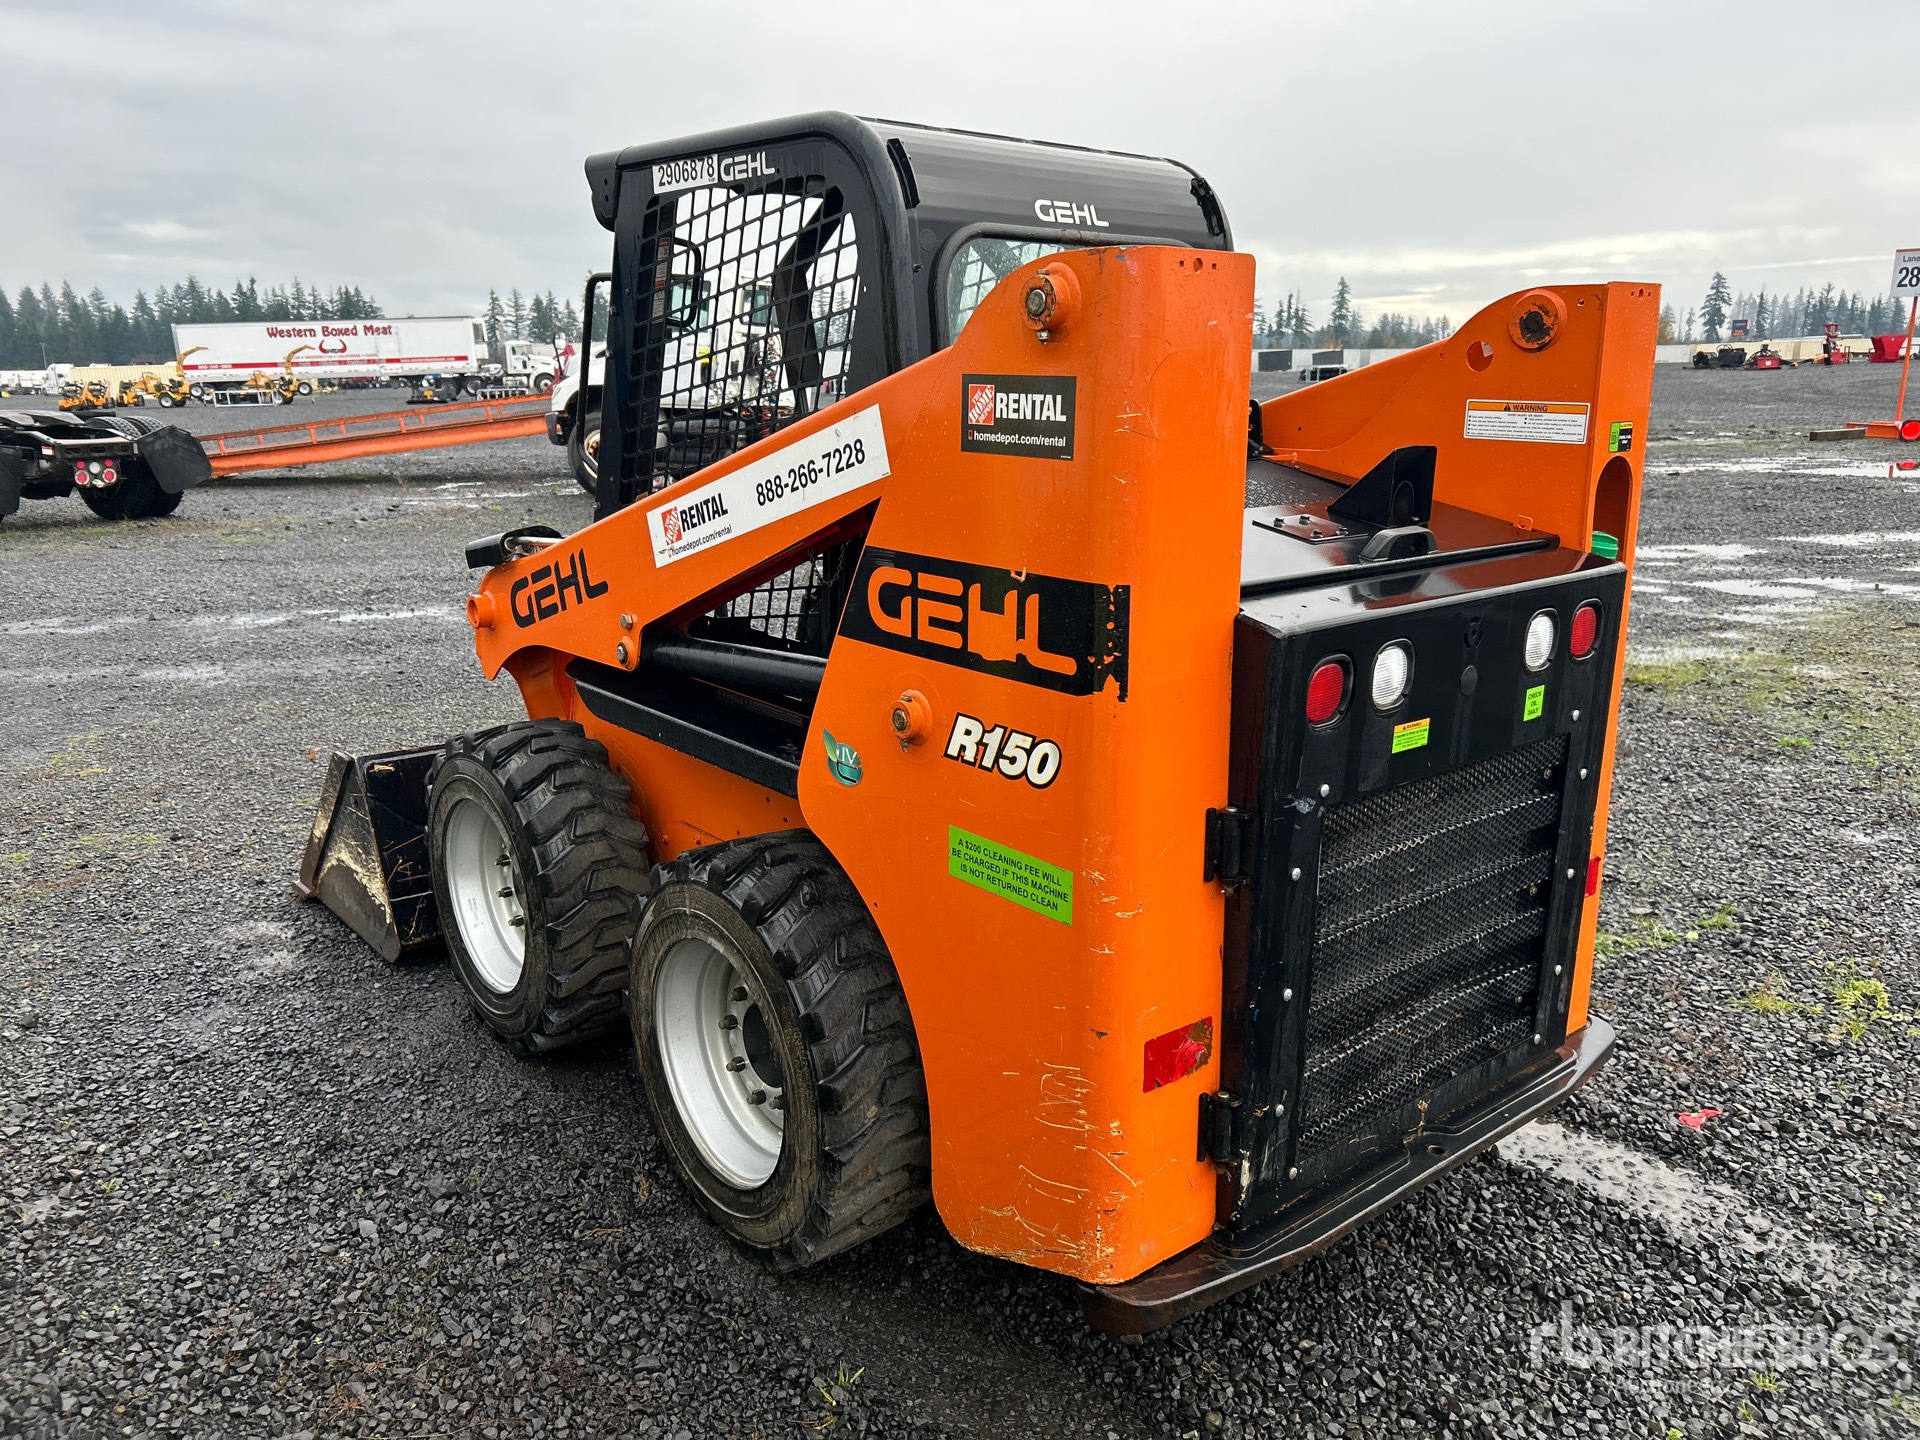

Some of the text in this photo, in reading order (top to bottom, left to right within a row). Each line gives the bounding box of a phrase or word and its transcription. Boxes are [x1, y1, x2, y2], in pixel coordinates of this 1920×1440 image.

[658, 156, 715, 187] 2906878
[720, 151, 776, 182] GEHL
[1034, 199, 1110, 227] GEHL
[266, 324, 393, 338] Western Boxed Meat
[995, 392, 1067, 422] RENTAL
[974, 430, 1066, 447] homedepot.com/rental
[755, 438, 866, 507] 888-266-7228
[680, 492, 729, 533] RENTAL
[510, 548, 609, 629] GEHL
[867, 566, 1078, 676] GEHL
[1527, 707, 1540, 716] DAILY
[1528, 691, 1543, 699] CHECK
[945, 712, 1062, 790] R150
[951, 847, 1069, 903] BE CHARGED IF THIS MACHINE
[957, 838, 1062, 887] A $200 CLEANING FEE WILL
[960, 863, 1058, 912] IS NOT RETURNED CLEAN
